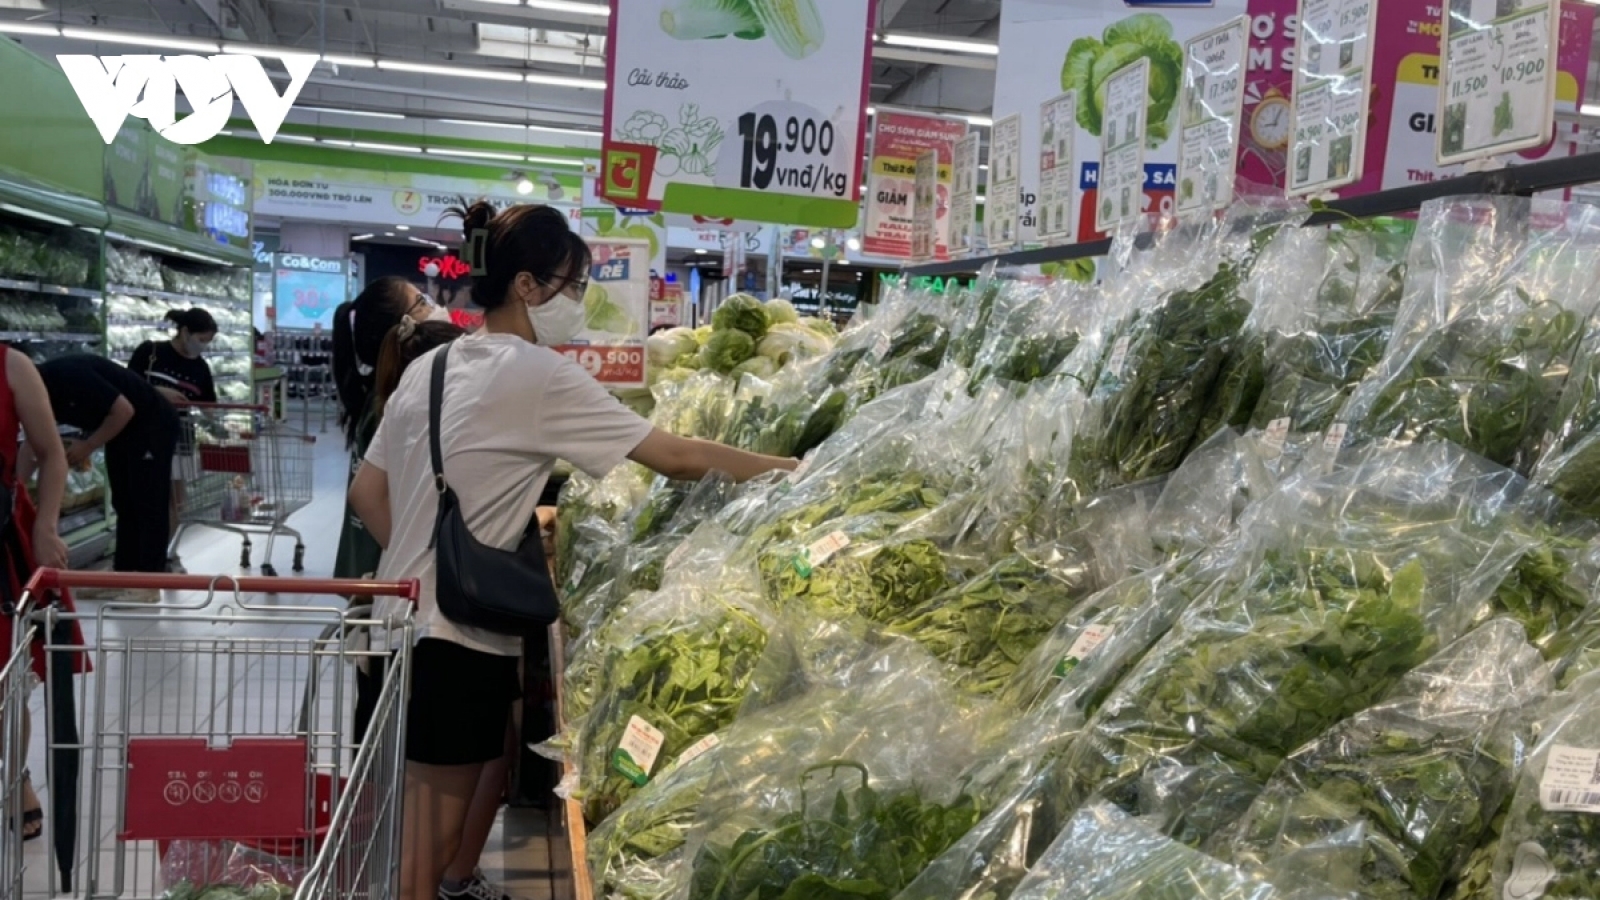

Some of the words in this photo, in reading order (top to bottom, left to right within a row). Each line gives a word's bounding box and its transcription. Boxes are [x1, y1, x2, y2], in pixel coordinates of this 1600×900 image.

[1500, 58, 1545, 84] 10.900
[1452, 75, 1488, 98] 11.500
[776, 163, 848, 197] vnđ/kg
[877, 188, 908, 206] GIẢM
[281, 255, 341, 272] Co&Com
